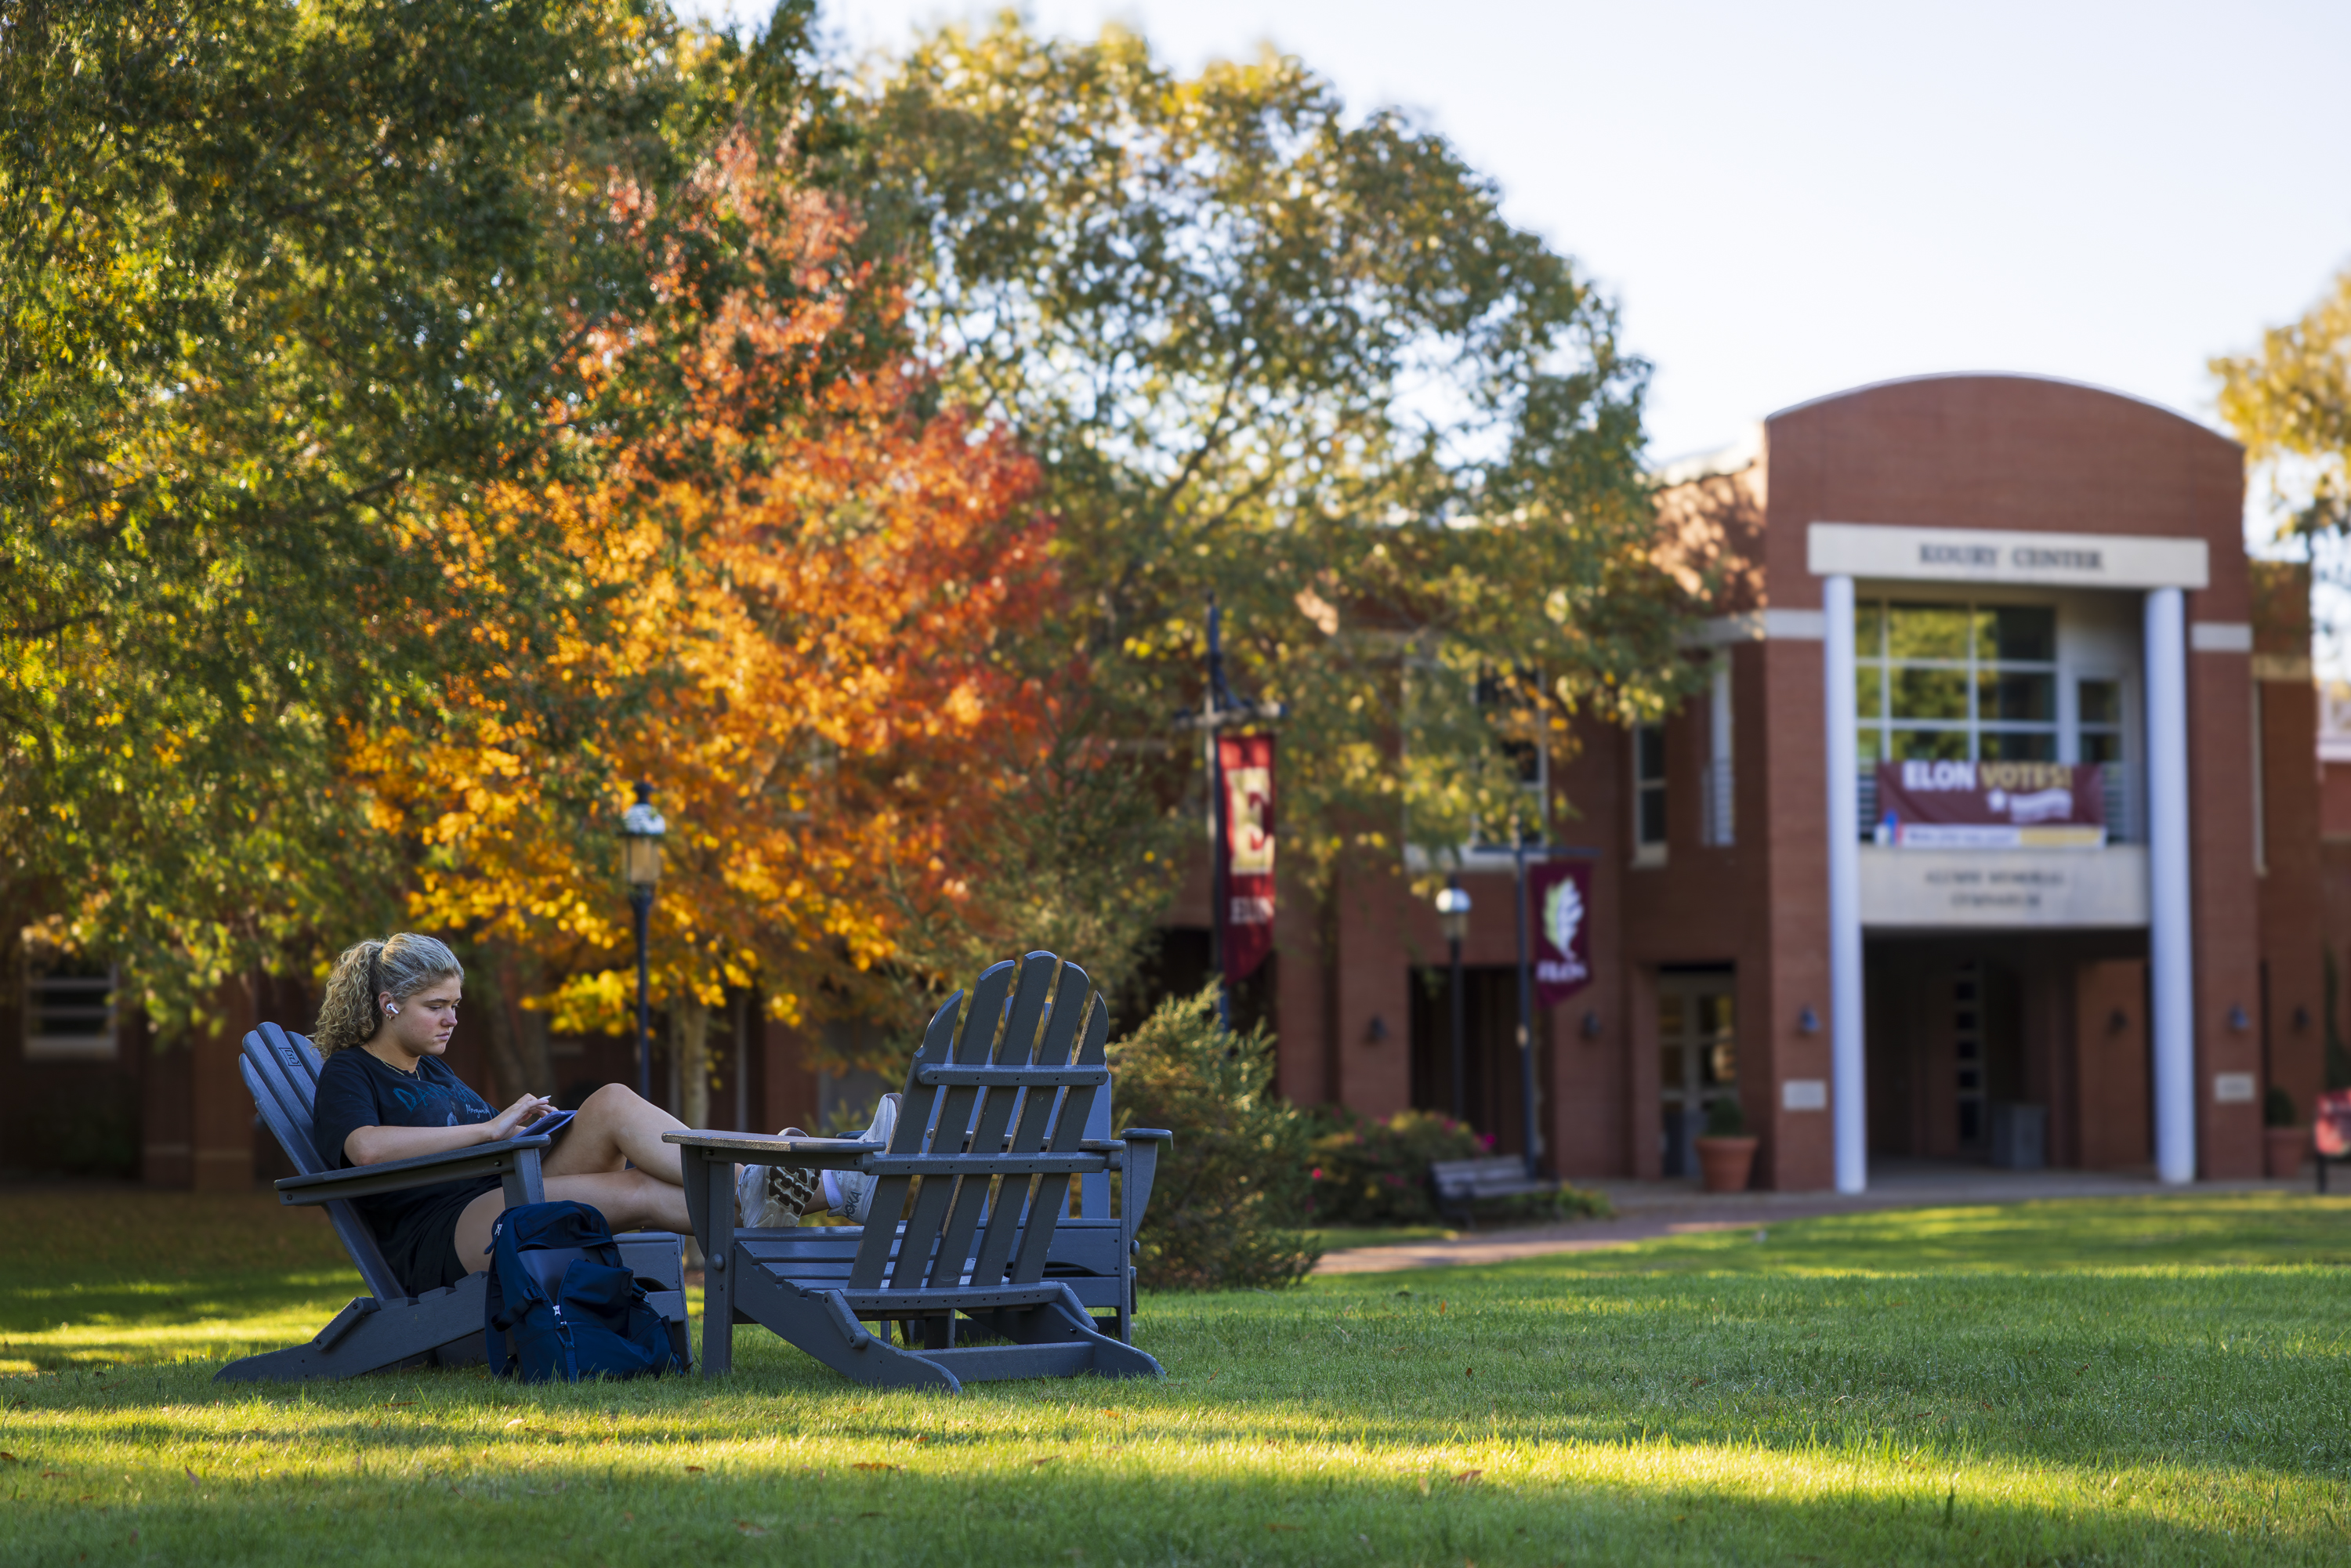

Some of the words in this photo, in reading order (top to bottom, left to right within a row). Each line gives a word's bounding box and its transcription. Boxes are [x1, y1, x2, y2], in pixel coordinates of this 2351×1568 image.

[2012, 548, 2105, 570] CENTER
[1903, 760, 1976, 791] ELON
[1226, 767, 1276, 875] E
[843, 1190, 862, 1219] HOKA
